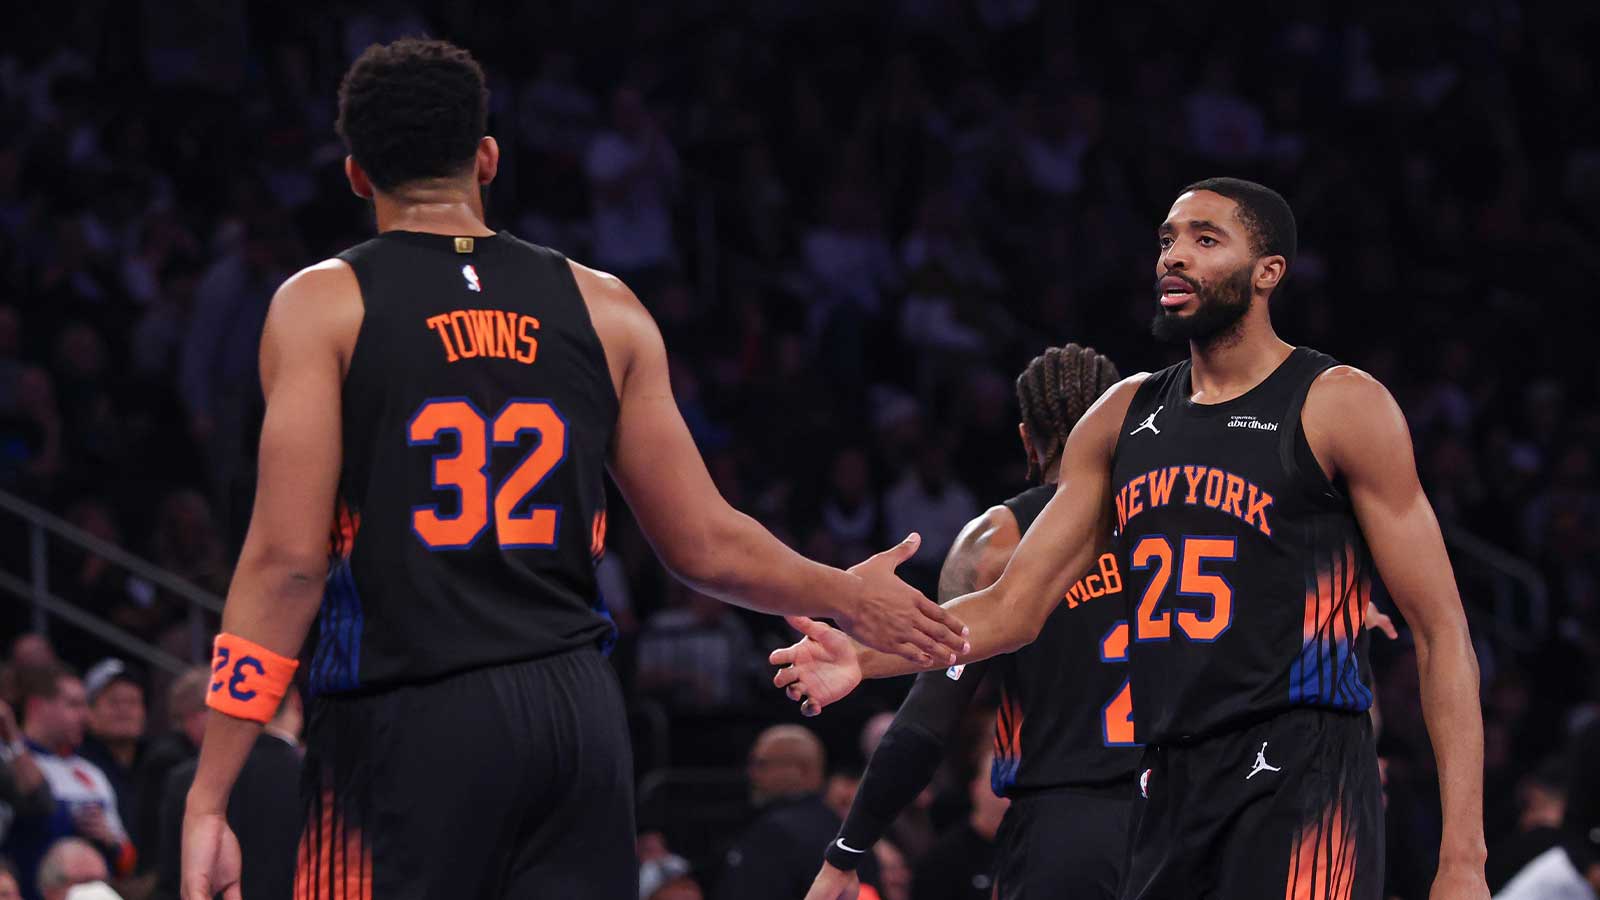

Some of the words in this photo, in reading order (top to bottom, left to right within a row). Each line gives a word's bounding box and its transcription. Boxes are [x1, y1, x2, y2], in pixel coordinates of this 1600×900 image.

[425, 309, 541, 366] TOWNS
[1227, 420, 1247, 428] abu
[1248, 420, 1279, 431] dhabi
[407, 396, 569, 551] 32
[1115, 466, 1180, 535] NEW
[1183, 465, 1273, 537] YORK
[1130, 533, 1238, 643] 25
